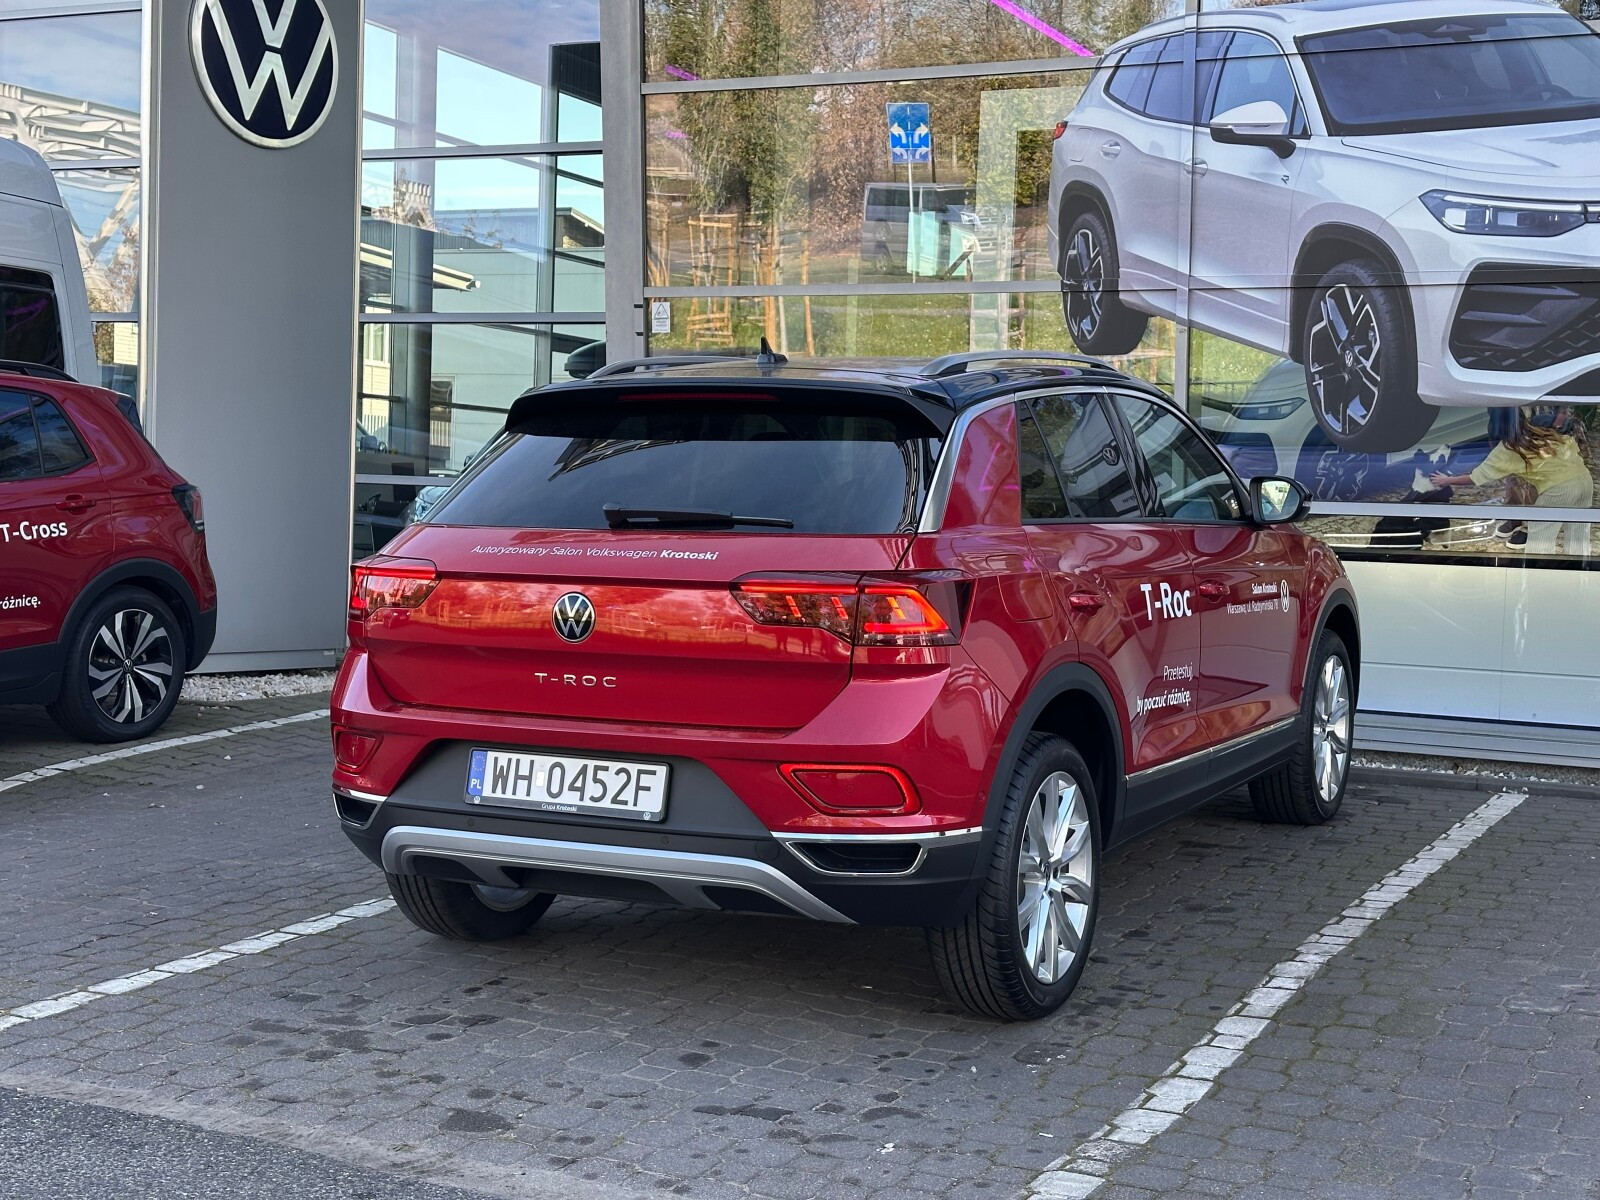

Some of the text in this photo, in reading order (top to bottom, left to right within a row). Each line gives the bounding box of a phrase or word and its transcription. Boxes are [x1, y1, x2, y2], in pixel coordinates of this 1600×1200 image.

[0, 521, 68, 542] T-Cross
[471, 545, 719, 561] Autoryzowany Salon Volkswagen Krotoski
[1251, 583, 1263, 594] Salon
[1140, 582, 1192, 621] T-Roc
[534, 672, 617, 688] T-ROC
[1163, 661, 1193, 682] Przetestuj
[1136, 687, 1192, 716] by poczuć różnicę.
[470, 778, 482, 790] PL
[491, 756, 657, 807] WH 0452F
[556, 804, 578, 812] Krotoski
